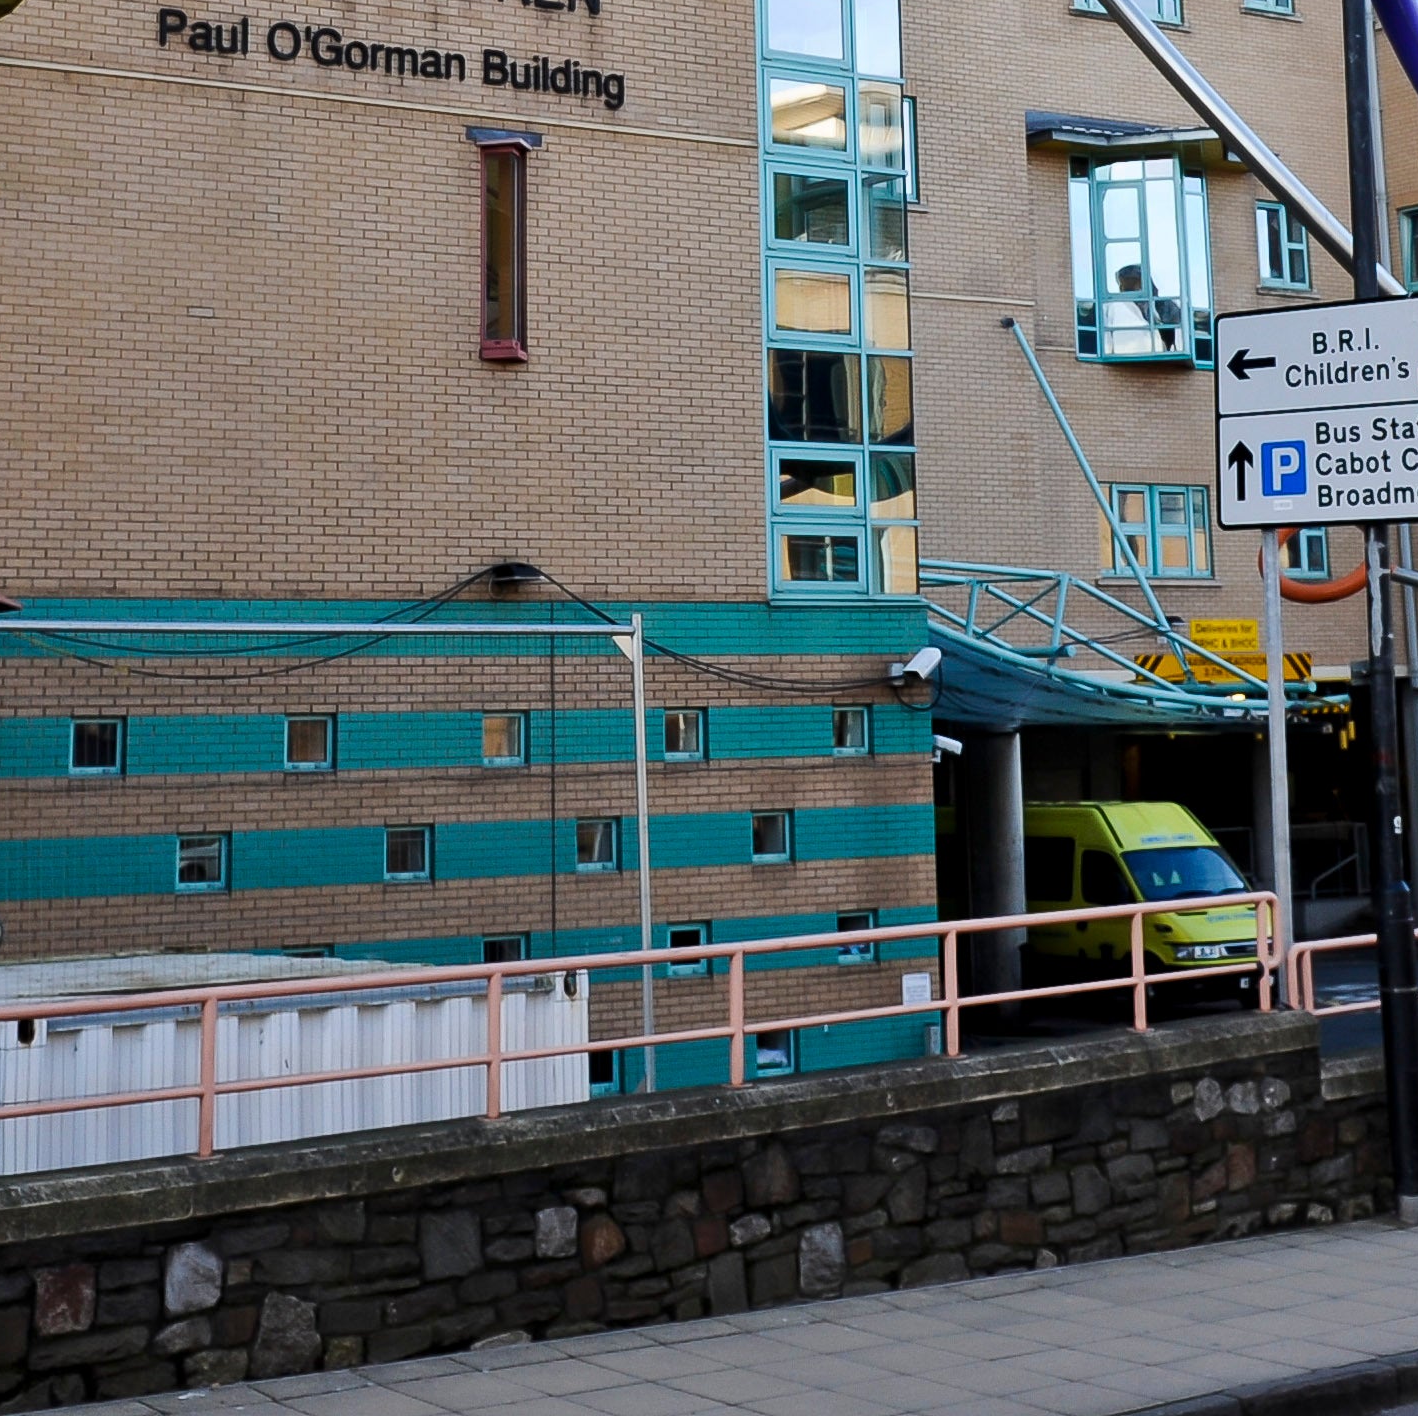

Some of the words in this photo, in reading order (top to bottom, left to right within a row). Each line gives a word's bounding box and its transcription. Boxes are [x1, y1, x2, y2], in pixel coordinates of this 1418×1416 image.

[157, 8, 249, 56] Paul
[266, 21, 466, 82] O'Gorman
[483, 49, 625, 111] Building
[1312, 328, 1379, 354] B.R.I.
[1285, 356, 1410, 388] Children's
[1315, 421, 1361, 444] Bus
[1272, 447, 1300, 491] P
[1315, 450, 1392, 475] Cabot
[1195, 623, 1238, 634] Deliveries
[1240, 623, 1254, 634] for
